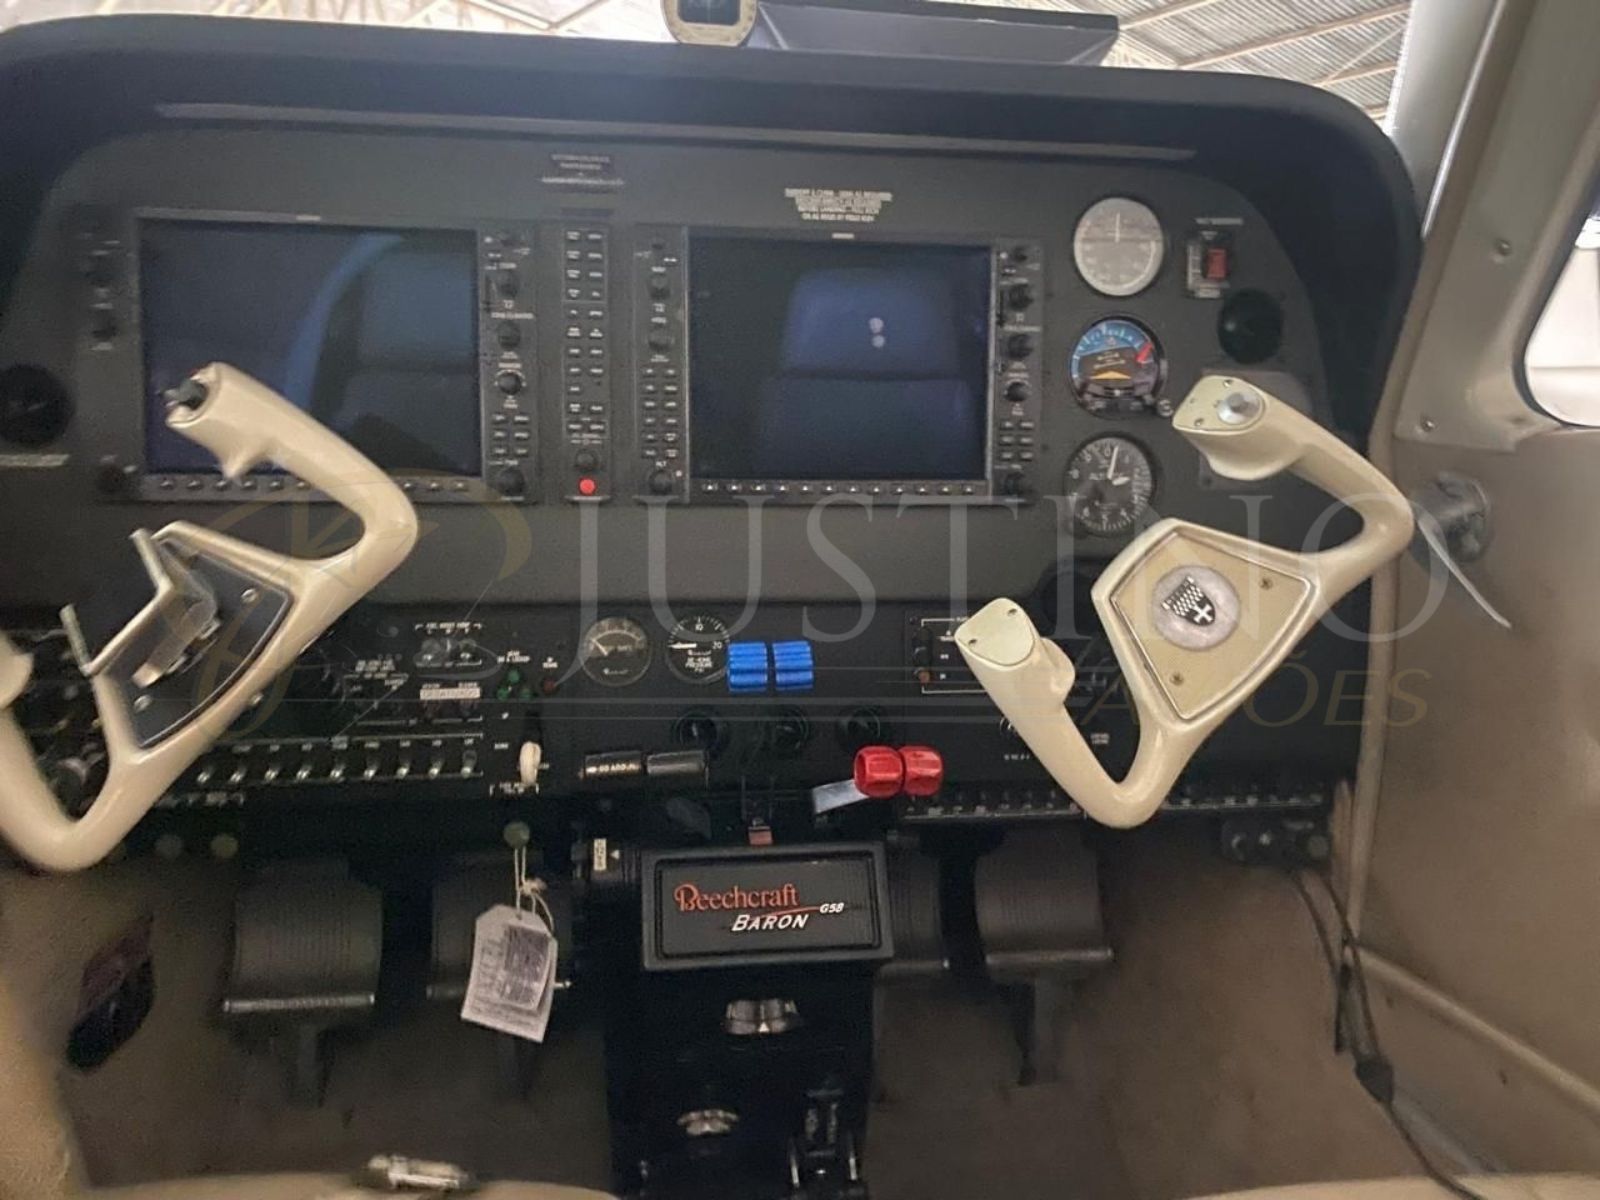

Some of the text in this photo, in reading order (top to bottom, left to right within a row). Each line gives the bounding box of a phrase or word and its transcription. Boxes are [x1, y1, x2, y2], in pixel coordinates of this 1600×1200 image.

[674, 883, 798, 912] Beechcraft
[819, 902, 845, 914] G58
[731, 913, 808, 932] BARON
